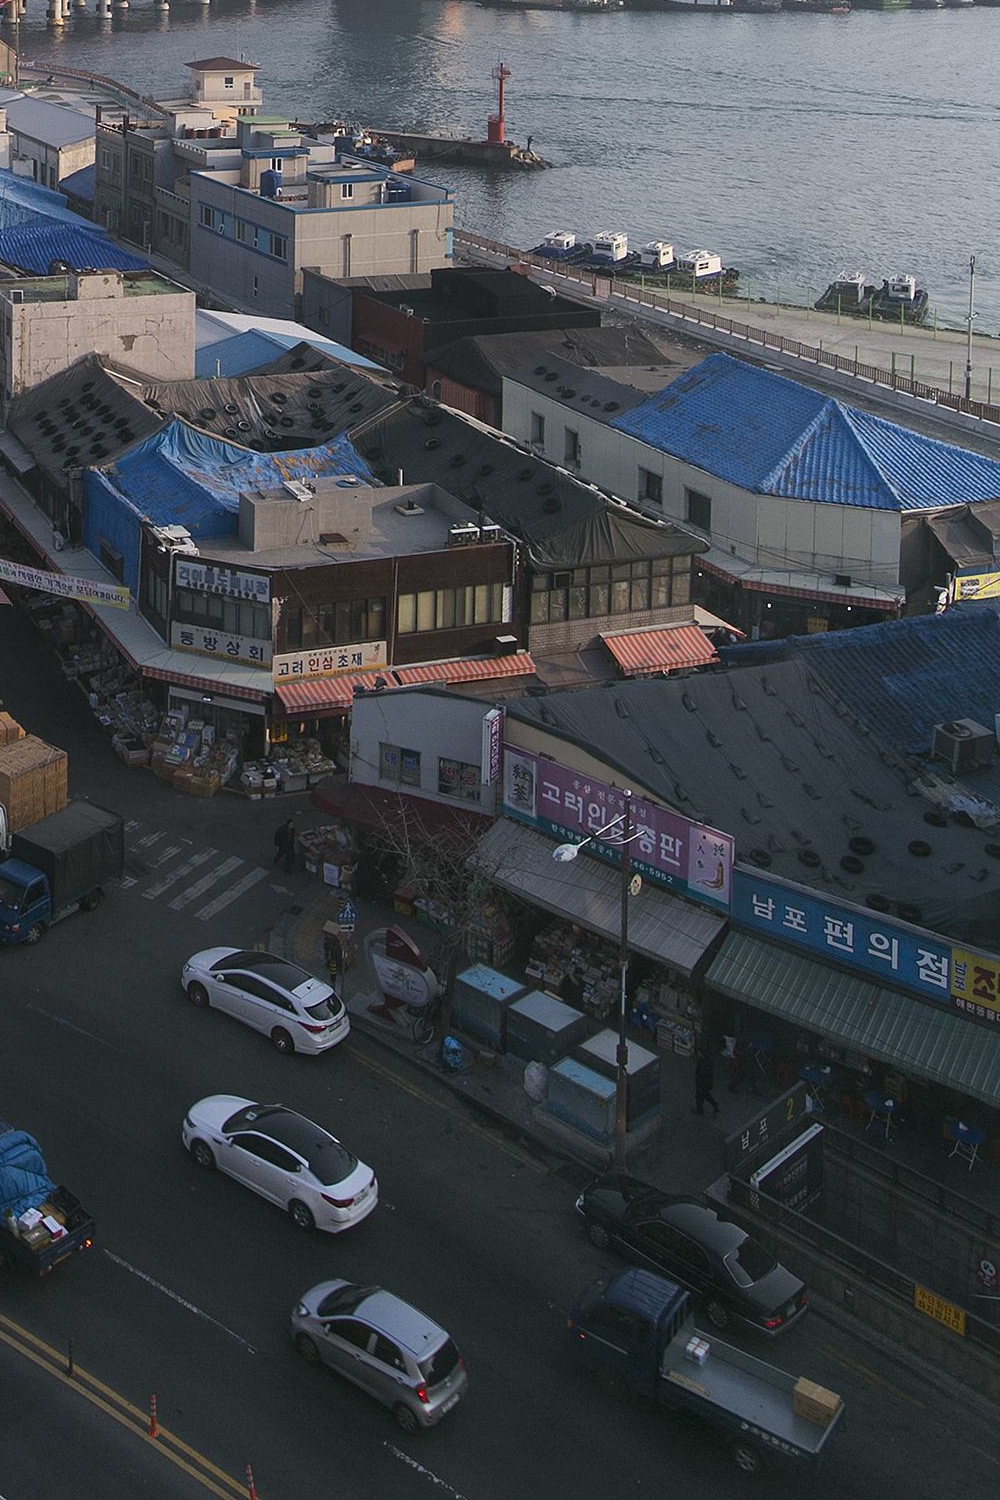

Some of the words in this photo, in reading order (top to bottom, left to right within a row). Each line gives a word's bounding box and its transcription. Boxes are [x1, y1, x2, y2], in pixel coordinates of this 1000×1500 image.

[18, 570, 42, 583] 저렴한
[45, 576, 73, 592] 가격으로
[278, 660, 304, 676] 고려
[308, 656, 334, 672] 인삼
[337, 652, 362, 668] 초재
[954, 958, 968, 992] 남포
[786, 1098, 794, 1121] 2
[919, 1289, 961, 1321] 무단횡단을
